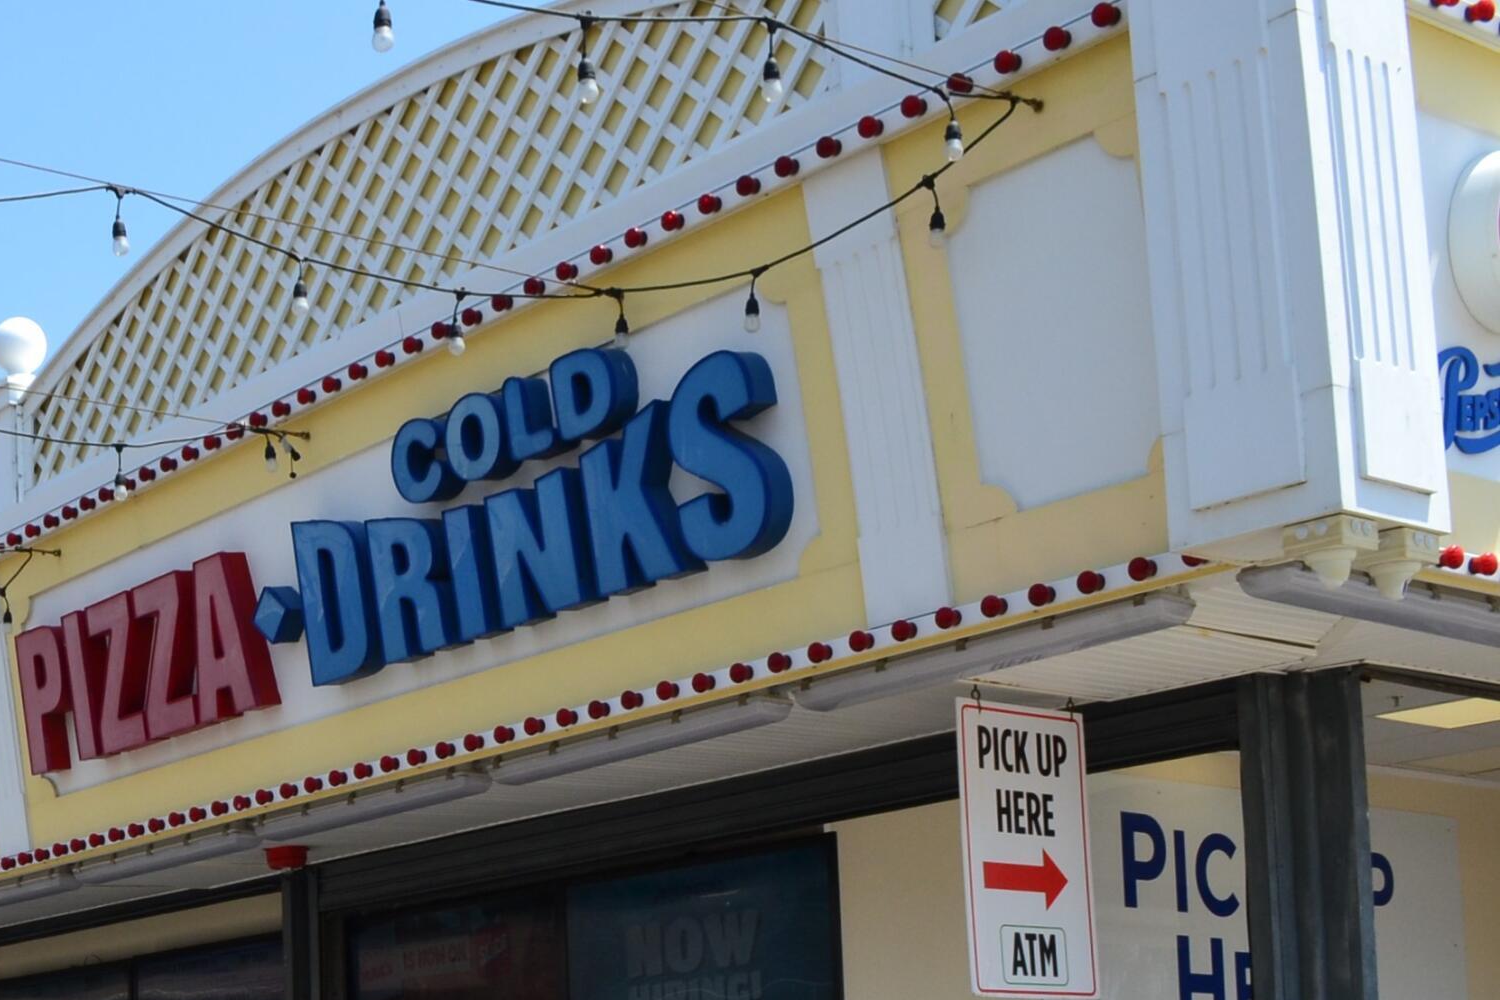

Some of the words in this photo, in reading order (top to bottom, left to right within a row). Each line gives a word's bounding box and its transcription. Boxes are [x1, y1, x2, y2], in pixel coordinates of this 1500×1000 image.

[392, 348, 638, 503] COLD
[1437, 346, 1500, 451] PEPS
[291, 350, 794, 687] DRINKS
[15, 551, 281, 775] PIZZA
[977, 726, 1030, 777] PICK
[1037, 735, 1067, 777] UP
[996, 789, 1056, 837] HERE
[1120, 811, 1241, 917] PIC
[627, 912, 757, 977] NOW
[1012, 932, 1058, 977] ATM
